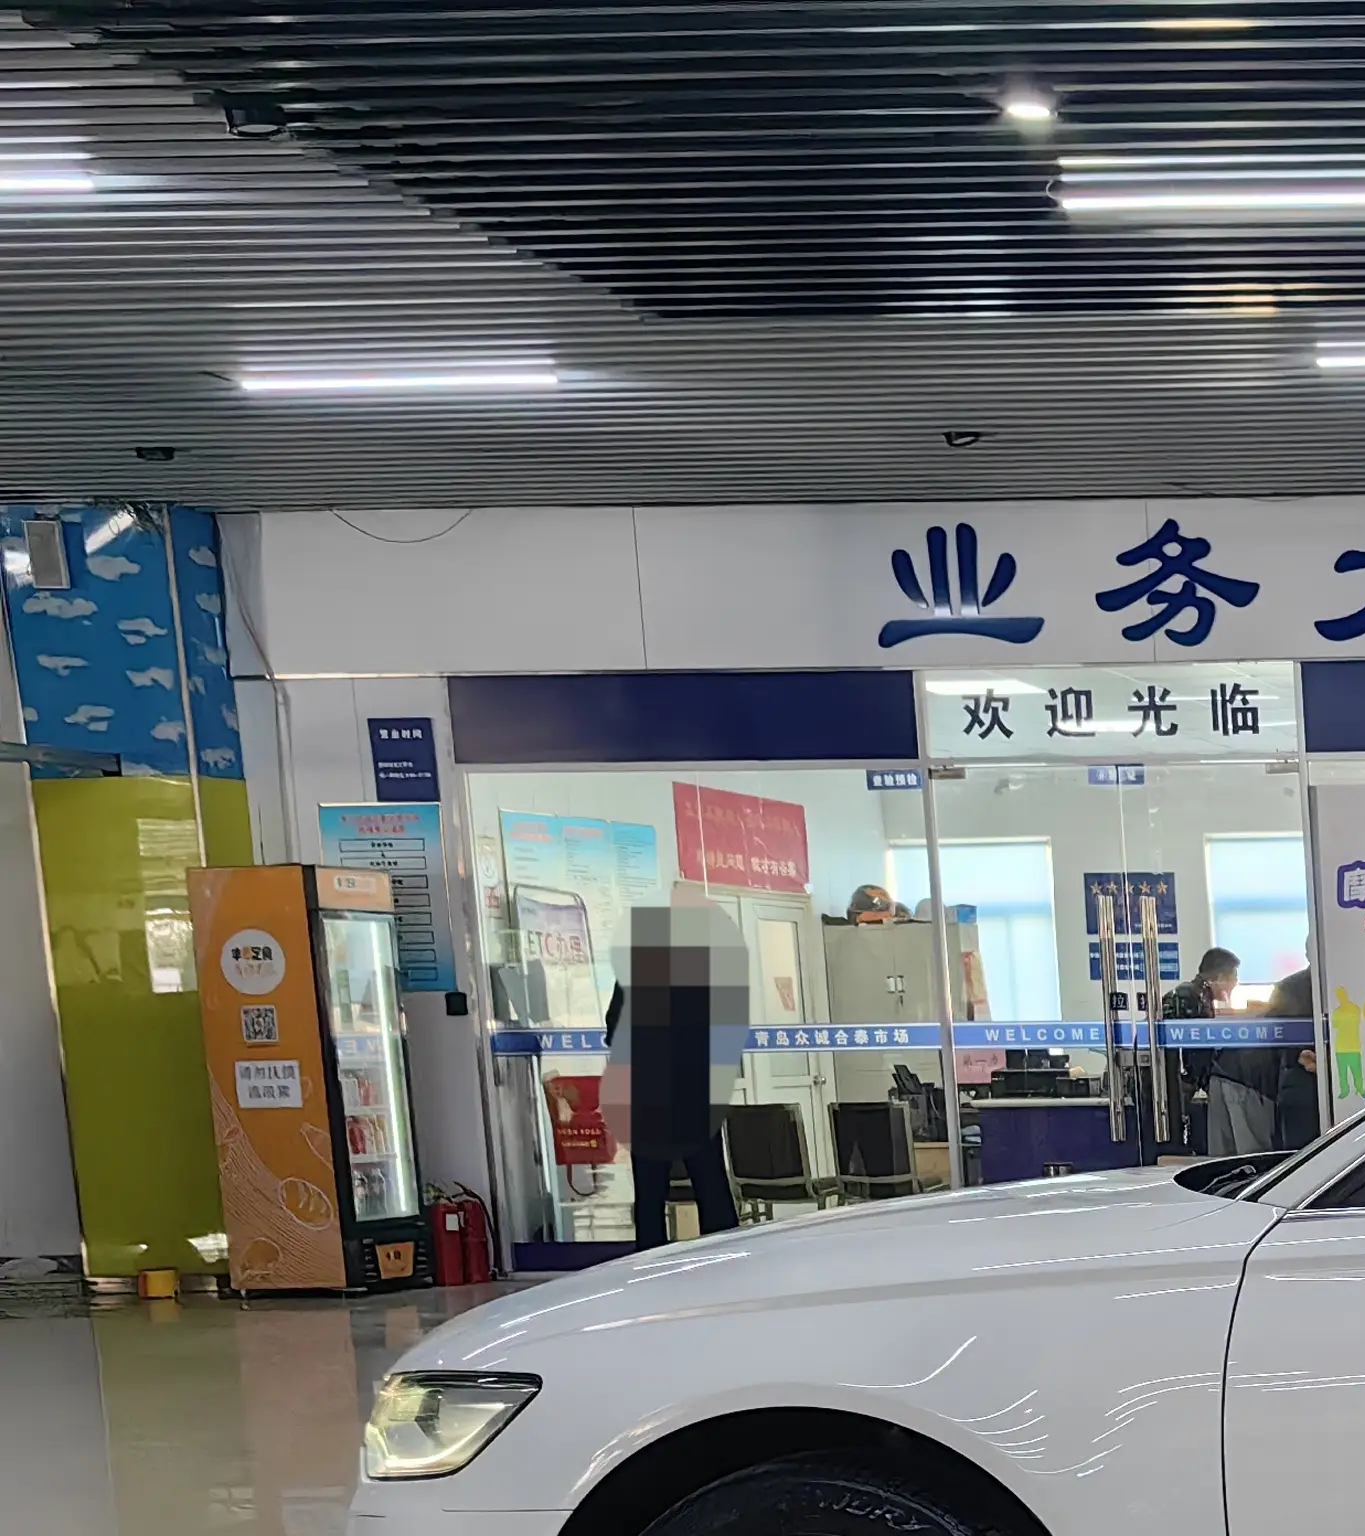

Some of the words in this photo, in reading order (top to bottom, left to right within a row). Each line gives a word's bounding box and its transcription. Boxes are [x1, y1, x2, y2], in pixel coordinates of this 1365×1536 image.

[962, 681, 1261, 739] 欢迎光临
[755, 1028, 909, 1047] 青岛众诚合泰市场
[985, 1027, 1101, 1041] WELCOME
[1170, 1026, 1285, 1041] WELCOME
